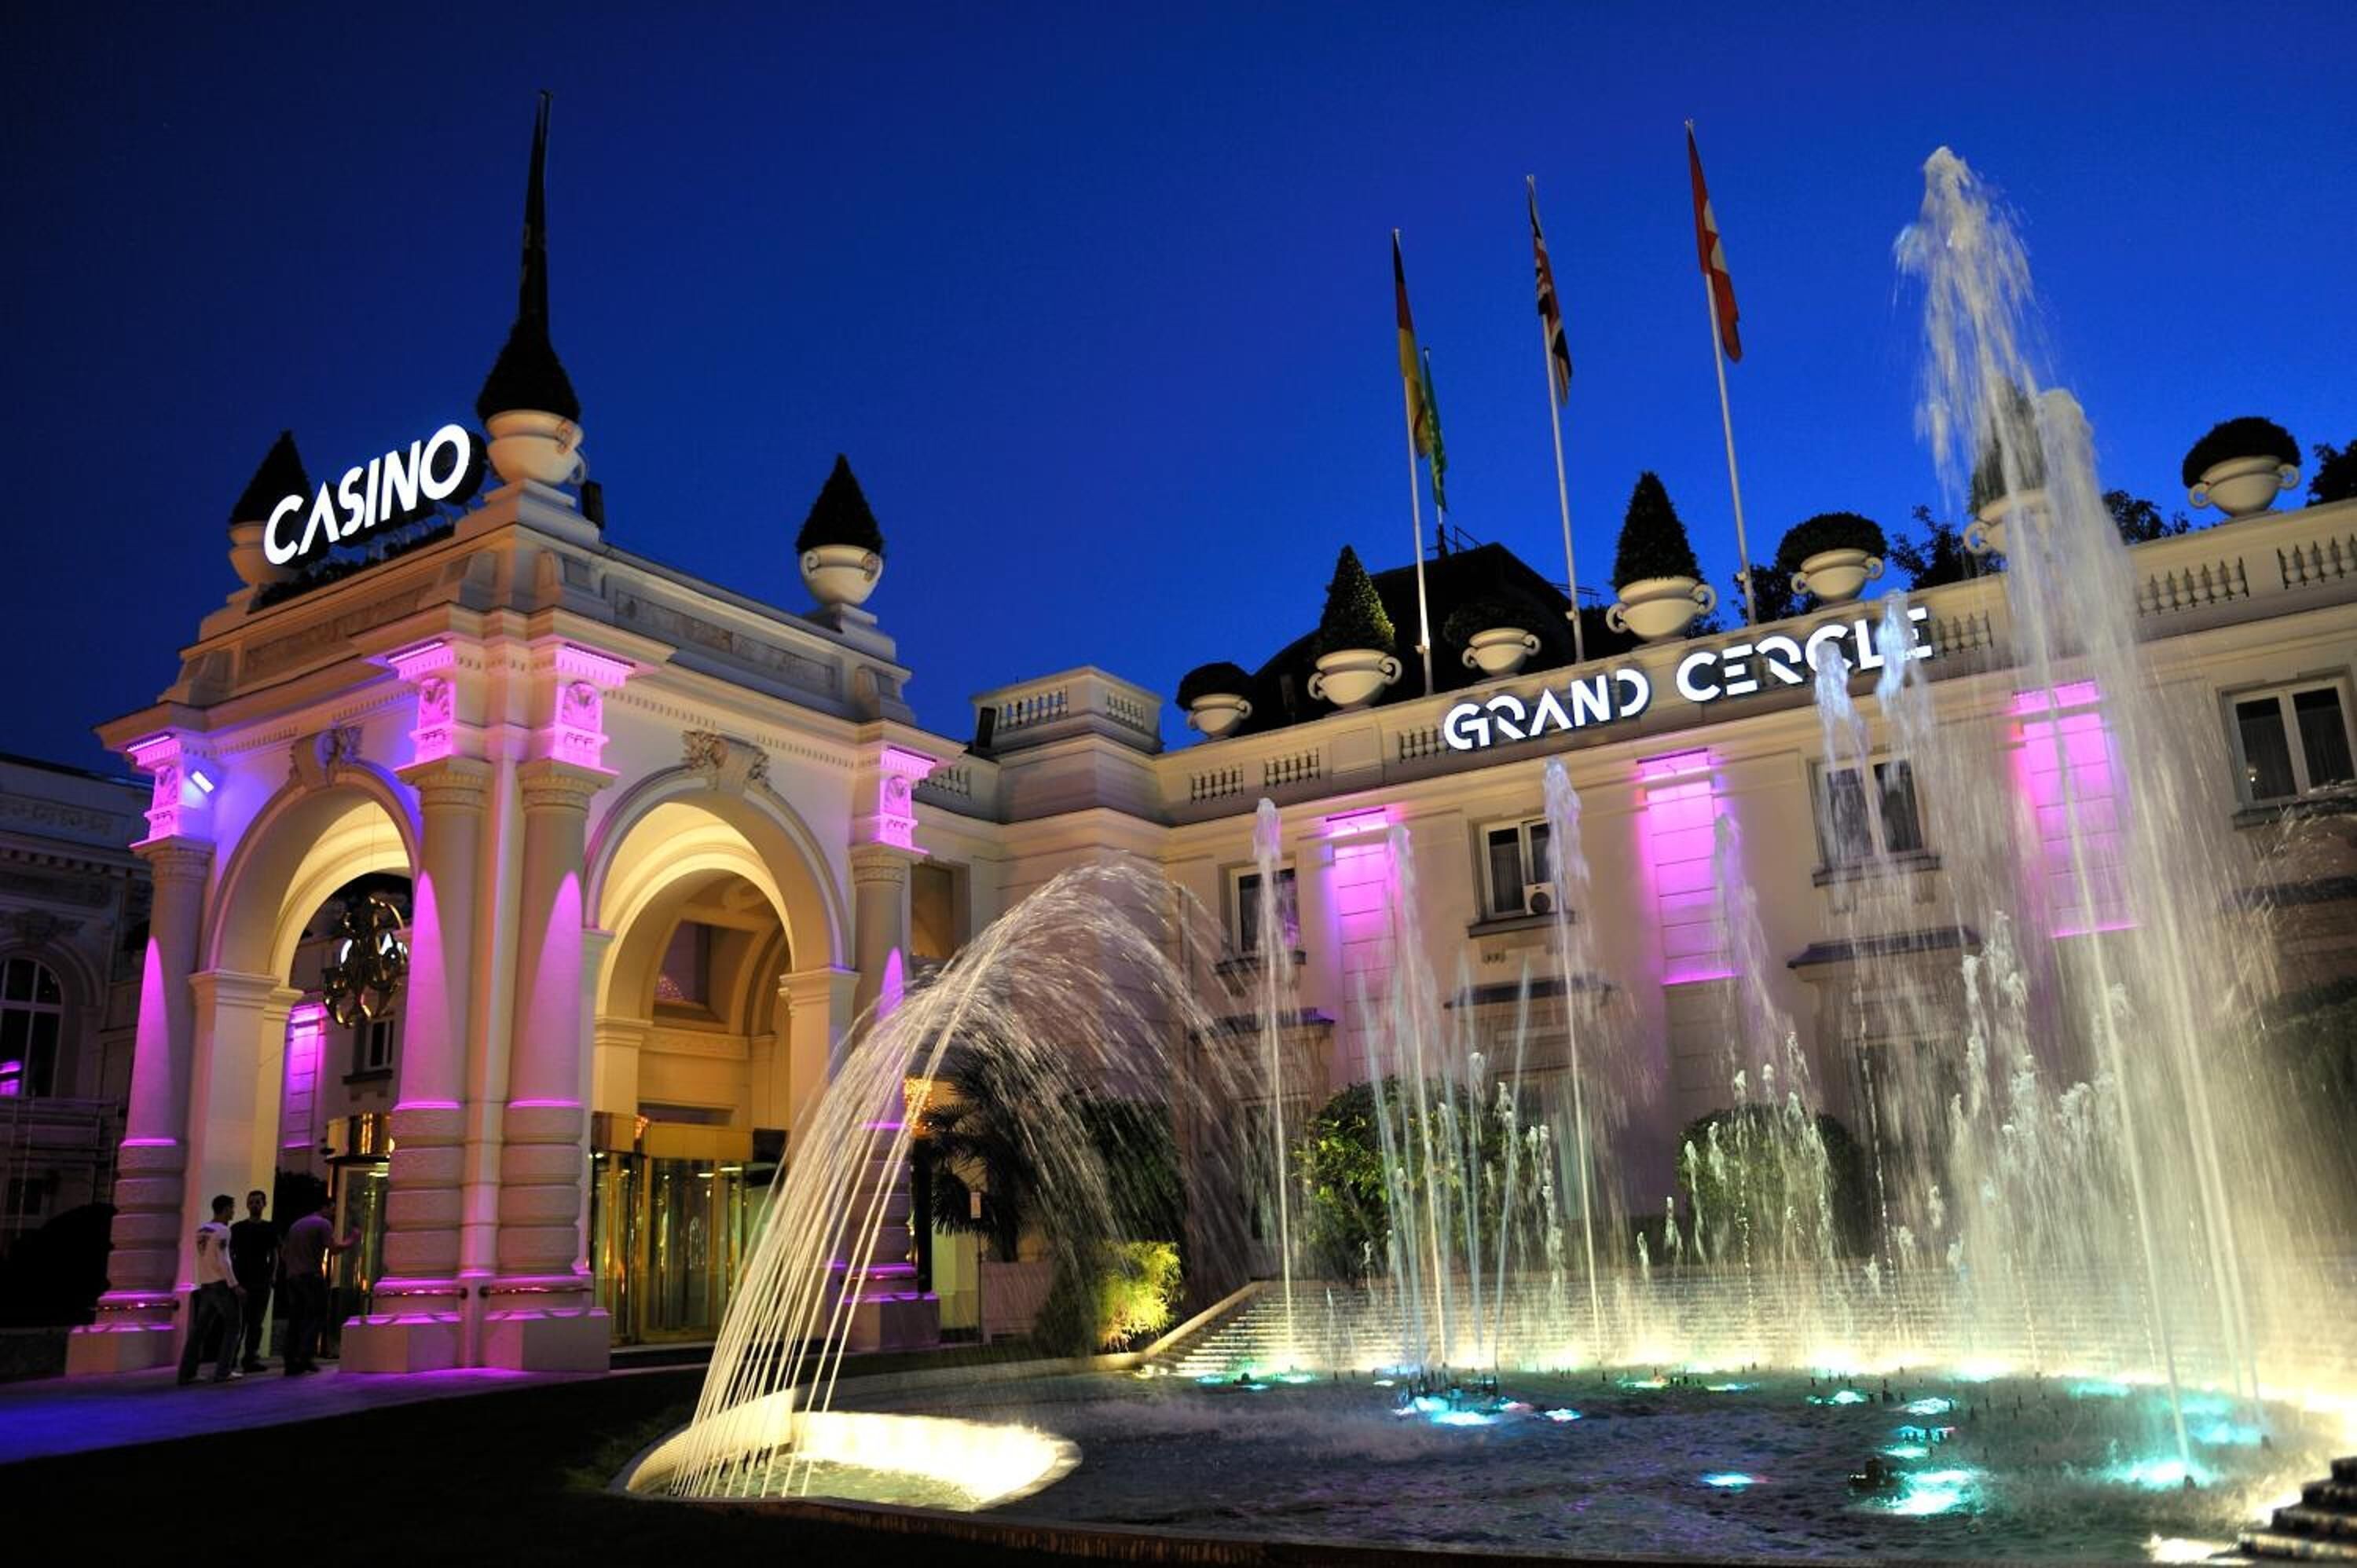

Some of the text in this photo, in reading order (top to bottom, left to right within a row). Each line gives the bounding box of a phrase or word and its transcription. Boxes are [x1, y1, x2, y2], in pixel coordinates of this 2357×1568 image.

[264, 423, 471, 565] CASINO
[1443, 606, 1934, 750] GRAND CERCLE
